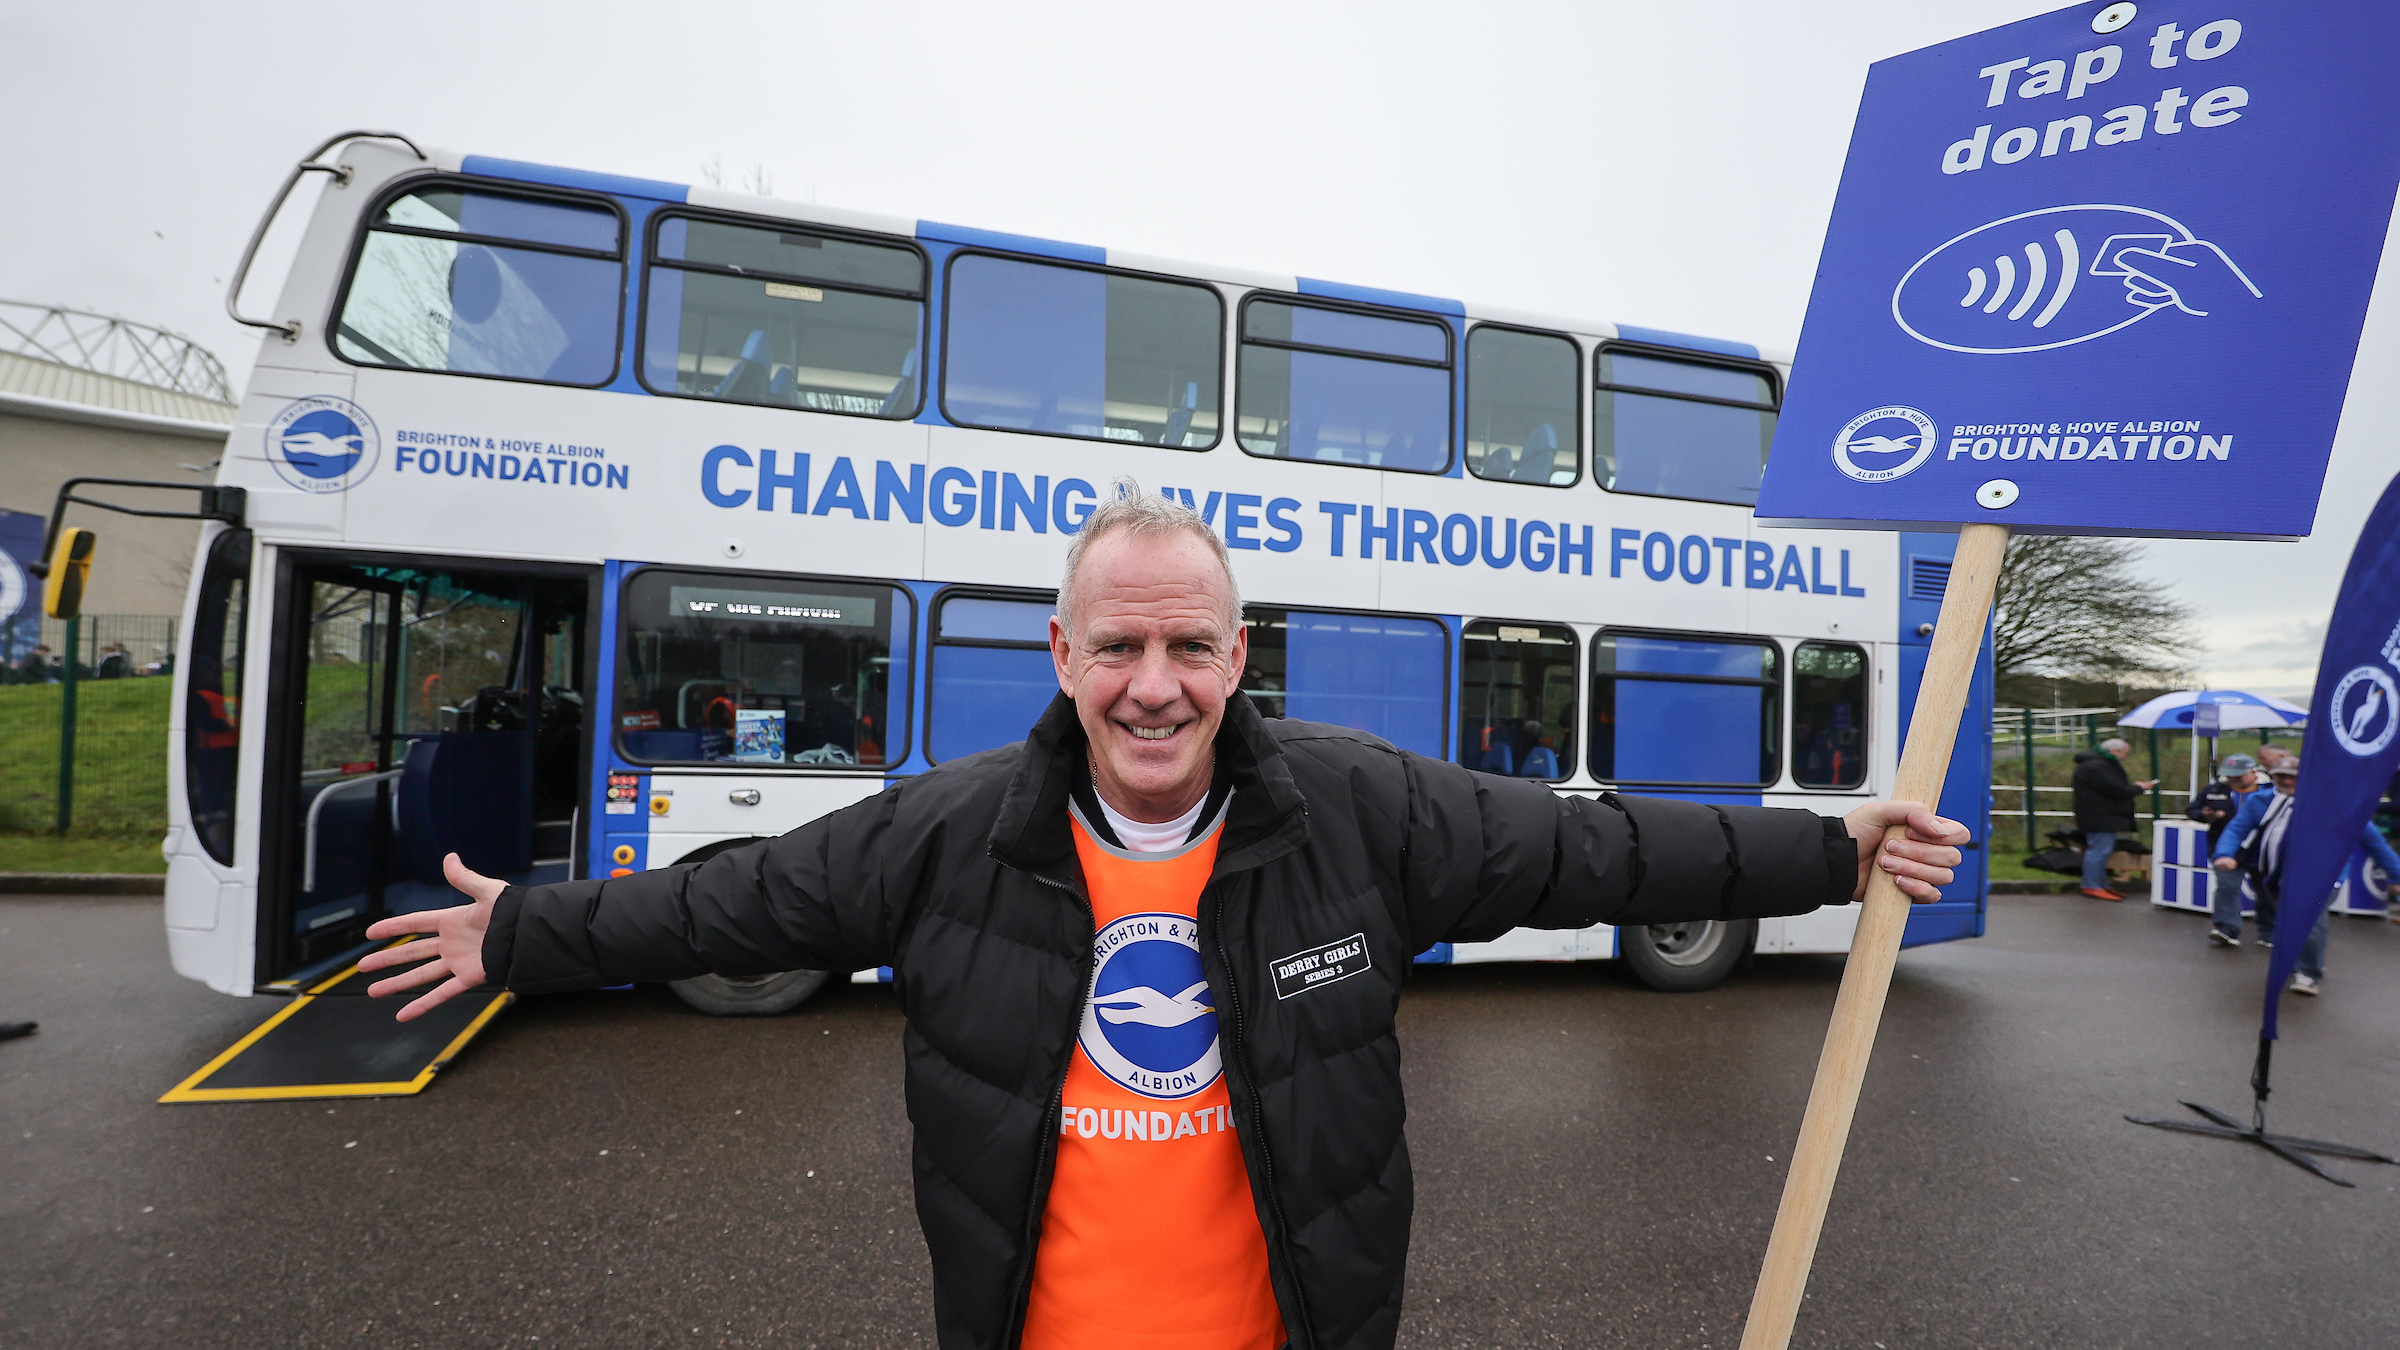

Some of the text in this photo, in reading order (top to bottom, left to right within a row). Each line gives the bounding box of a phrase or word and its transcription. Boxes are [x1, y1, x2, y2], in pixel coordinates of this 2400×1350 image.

[1979, 19, 2243, 108] Tap to
[1941, 85, 2249, 175] donate
[1848, 410, 1896, 431] BRIGHTON
[1909, 413, 1930, 429] HOVE
[1953, 420, 2201, 436] BRIGHTON & HOVE ALBION
[397, 430, 605, 459] BRIGHTON & HOVE ALBION
[1946, 434, 2234, 461] FOUNDATION
[395, 446, 629, 490] FOUNDATION
[1855, 471, 1894, 479] ALBION
[700, 445, 1866, 598] CHANGING VES THROUGH FOOTBALL
[1169, 924, 1180, 937] &
[1278, 942, 1361, 980] DERRY GIRLS
[1304, 964, 1344, 984] SERIES 3
[1128, 1071, 1197, 1091] ALBION
[1060, 1105, 1237, 1141] FOUNDATI
